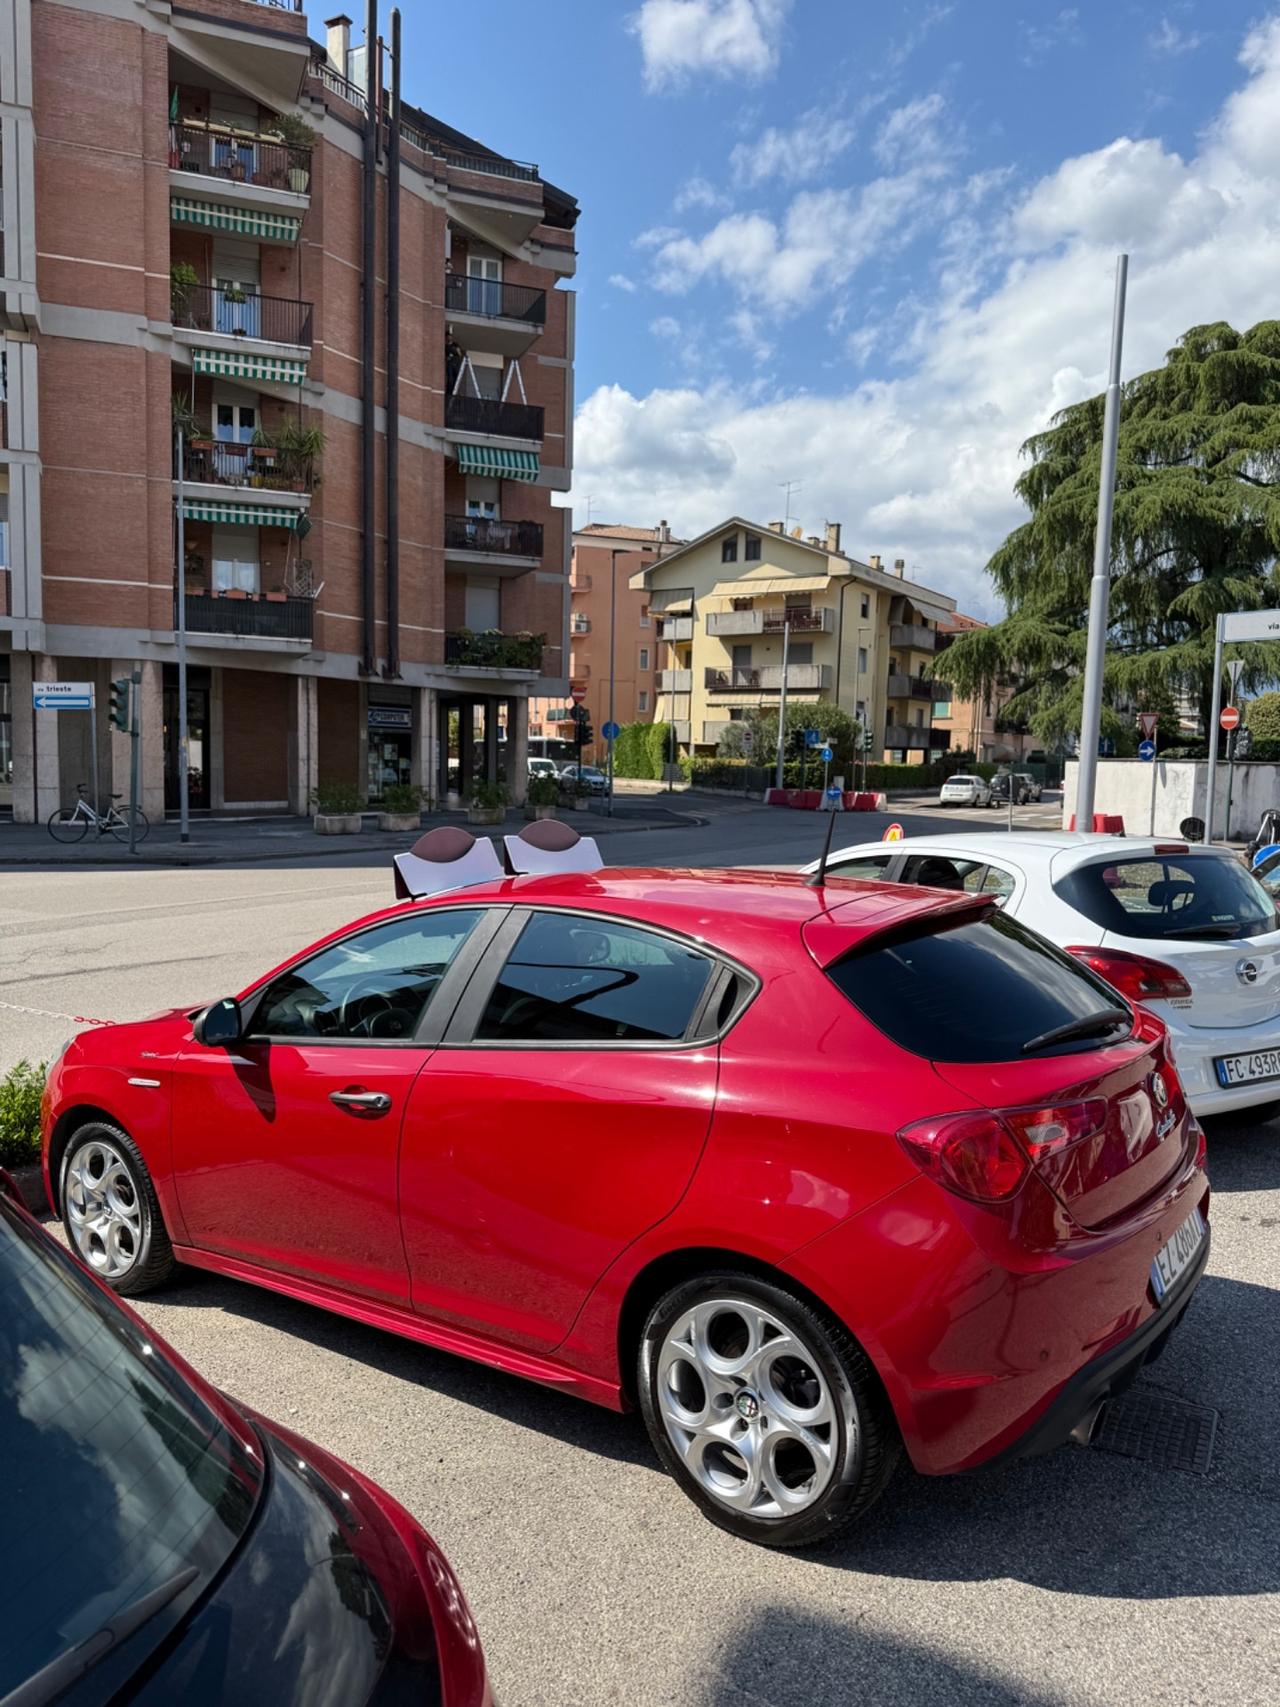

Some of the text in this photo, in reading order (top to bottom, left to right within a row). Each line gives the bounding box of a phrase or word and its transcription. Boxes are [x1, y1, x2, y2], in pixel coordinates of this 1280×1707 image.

[1268, 622, 1280, 630] via
[46, 684, 72, 692] trieste
[1226, 1052, 1280, 1081] FC 493R
[1156, 1242, 1177, 1285] EZ
